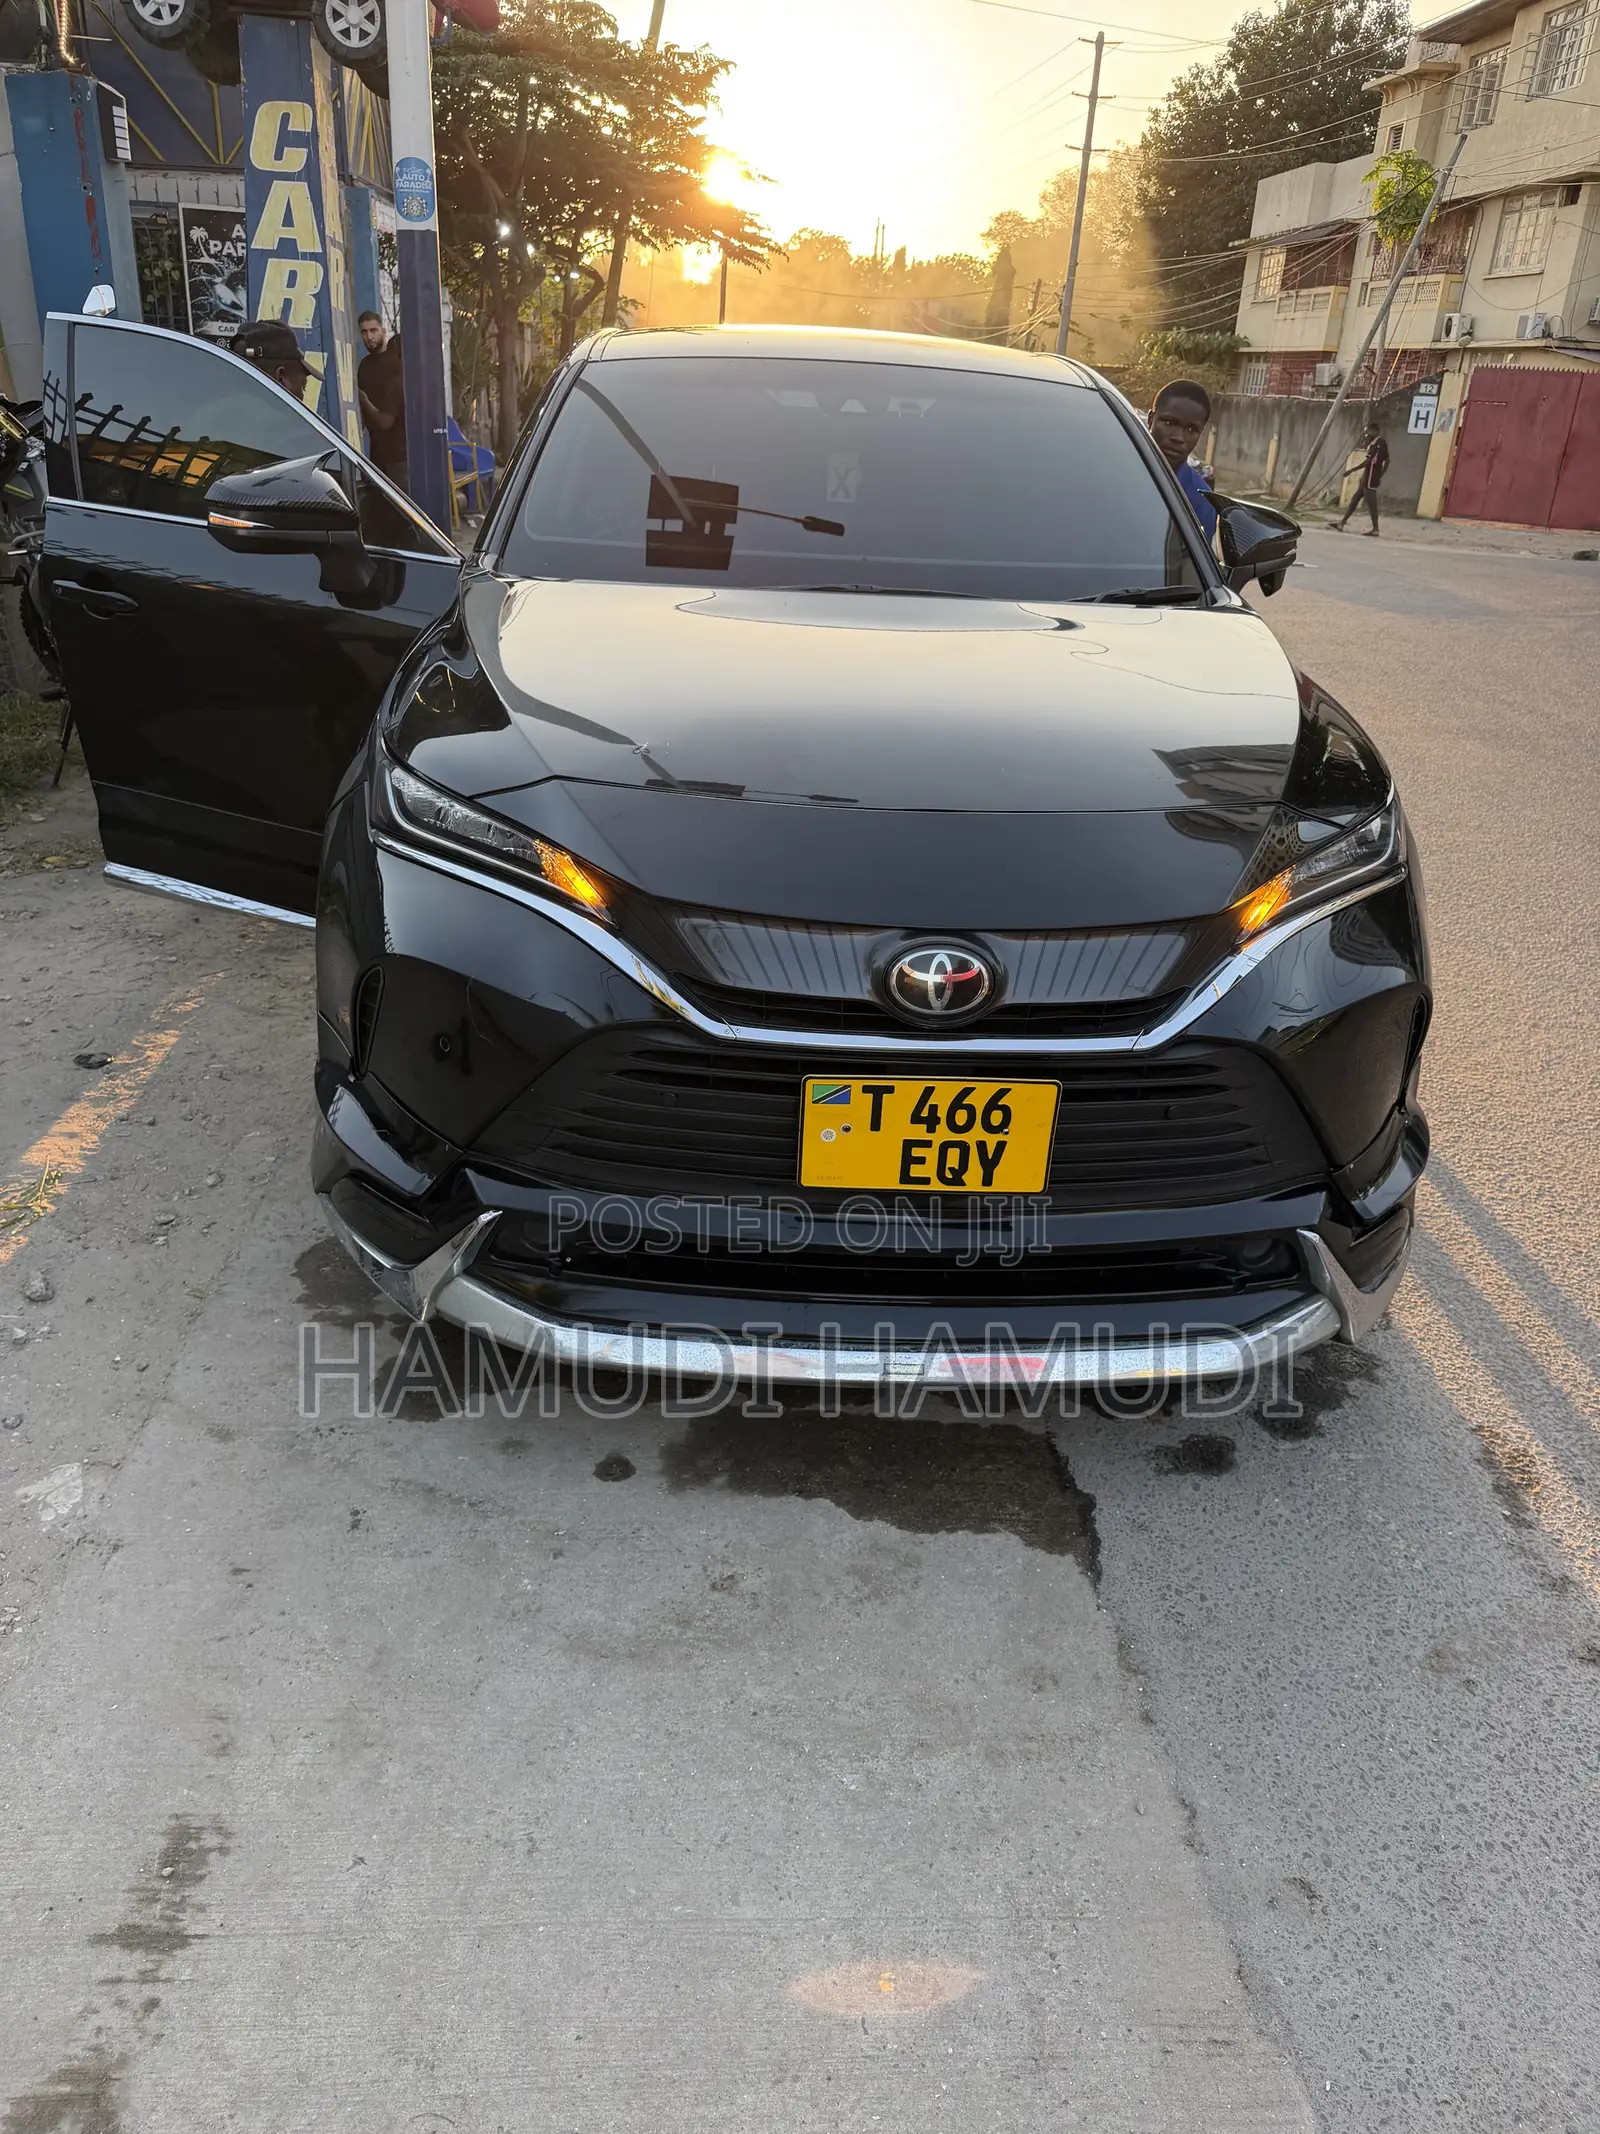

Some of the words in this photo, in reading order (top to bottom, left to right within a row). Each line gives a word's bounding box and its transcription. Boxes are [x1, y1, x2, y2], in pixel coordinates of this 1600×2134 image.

[402, 173, 425, 181] AUTO
[396, 181, 433, 190] PARADISE
[250, 101, 323, 329] CAR
[218, 325, 236, 333] CAR
[1424, 384, 1434, 393] 12
[1414, 410, 1430, 428] H
[862, 1084, 895, 1132] T
[910, 1086, 1012, 1135] 466
[899, 1139, 1008, 1187] EQY
